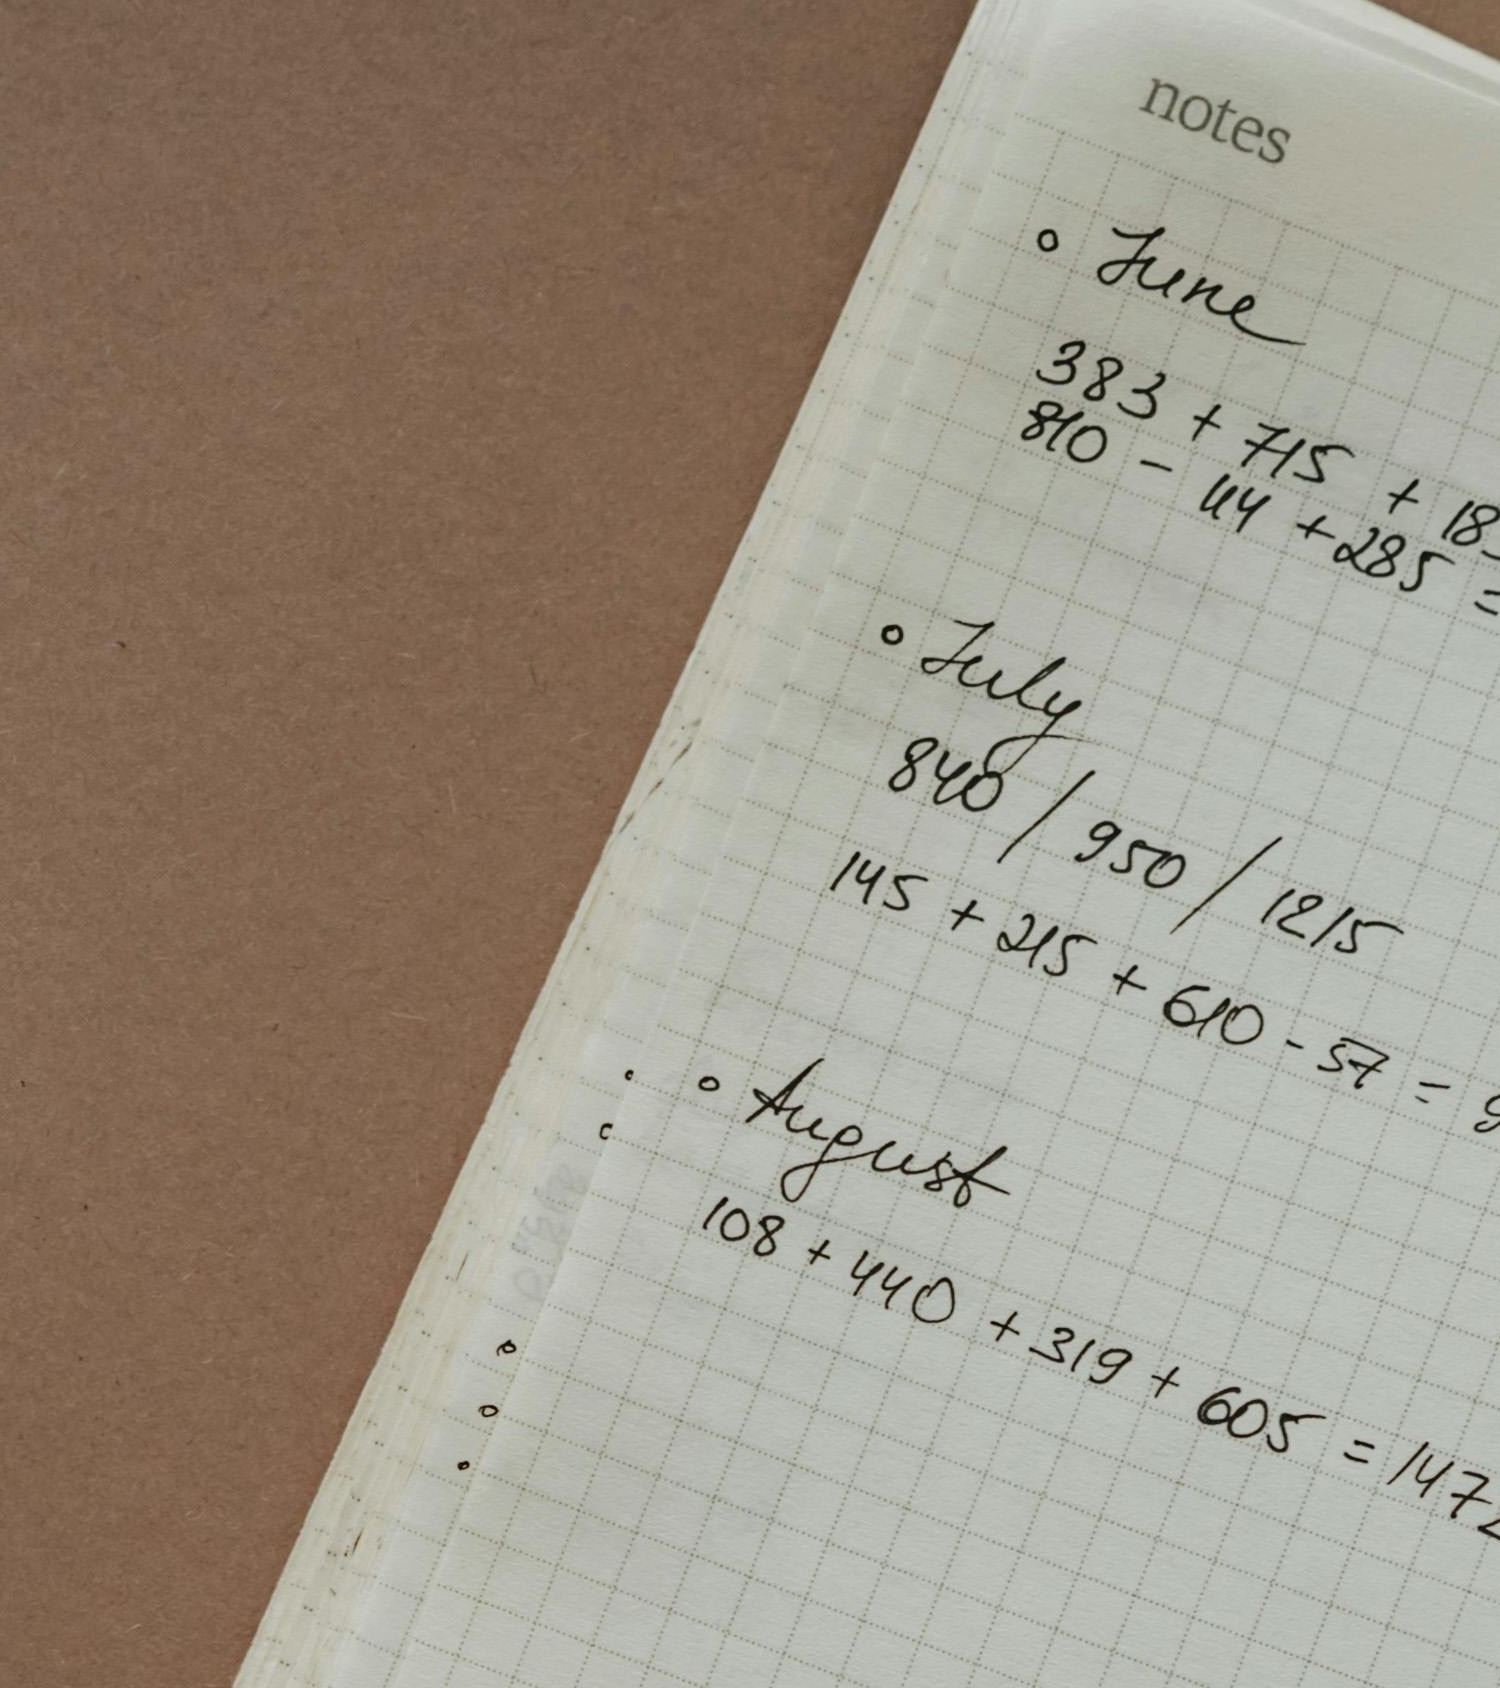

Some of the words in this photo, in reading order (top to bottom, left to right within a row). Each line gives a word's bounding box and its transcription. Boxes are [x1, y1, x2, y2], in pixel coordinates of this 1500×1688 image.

[1138, 73, 1293, 166] notes
[1095, 225, 1306, 346] June
[1037, 340, 1168, 418] 383
[1244, 422, 1355, 486] 715
[1334, 525, 1456, 591] 285
[920, 619, 1086, 778] July
[888, 738, 1004, 812] 840
[1074, 820, 1185, 889] 950
[1262, 888, 1404, 955] 1215
[830, 851, 928, 913] 145
[998, 913, 1098, 978] 215
[1162, 984, 1264, 1046] 610
[1316, 1037, 1391, 1089] 57
[752, 1058, 1010, 1207] August
[702, 1197, 787, 1257] 108
[850, 1250, 955, 1323] 440
[1029, 1325, 1133, 1385] 319
[1197, 1386, 1326, 1453] 605
